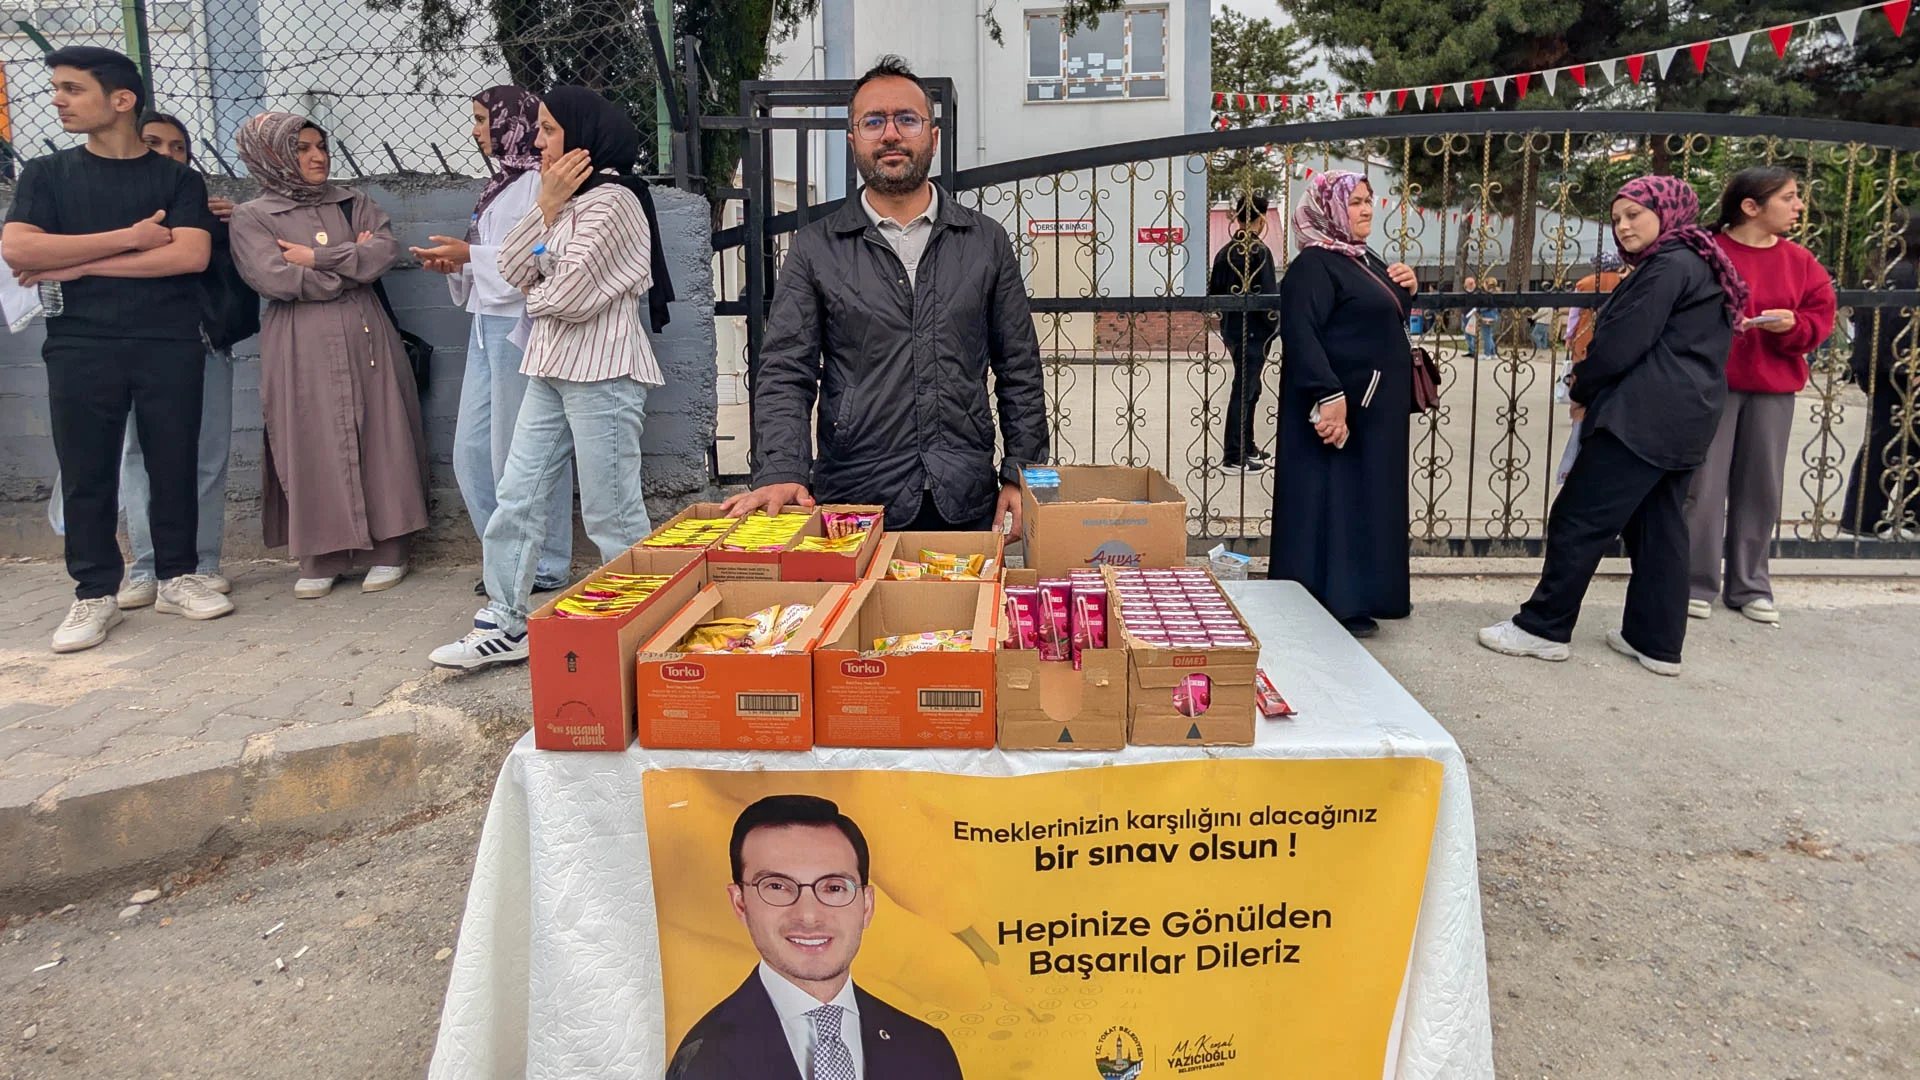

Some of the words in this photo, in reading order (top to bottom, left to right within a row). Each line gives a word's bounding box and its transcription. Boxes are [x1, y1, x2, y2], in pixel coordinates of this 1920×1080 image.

[1036, 223, 1064, 231] DERSLK
[1065, 222, 1088, 231] BİNASI
[665, 665, 700, 677] Torku
[844, 662, 880, 673] Torku
[571, 734, 607, 747] çubuk
[954, 813, 1119, 843] Emeklerinizin
[1127, 806, 1242, 832] karşılığını
[1249, 803, 1378, 829] alacağınız
[1035, 844, 1079, 872] bir
[1088, 842, 1179, 867] sınav
[1188, 833, 1279, 862] olsun
[1288, 832, 1298, 858] !
[998, 911, 1151, 946] Hepinize
[1162, 902, 1332, 938] Gönülden
[1029, 943, 1186, 980] Başarılar
[1196, 938, 1300, 971] Dileriz
[1098, 1025, 1117, 1043] TOKAT
[1167, 1049, 1236, 1069] YAZICIOĞLU
